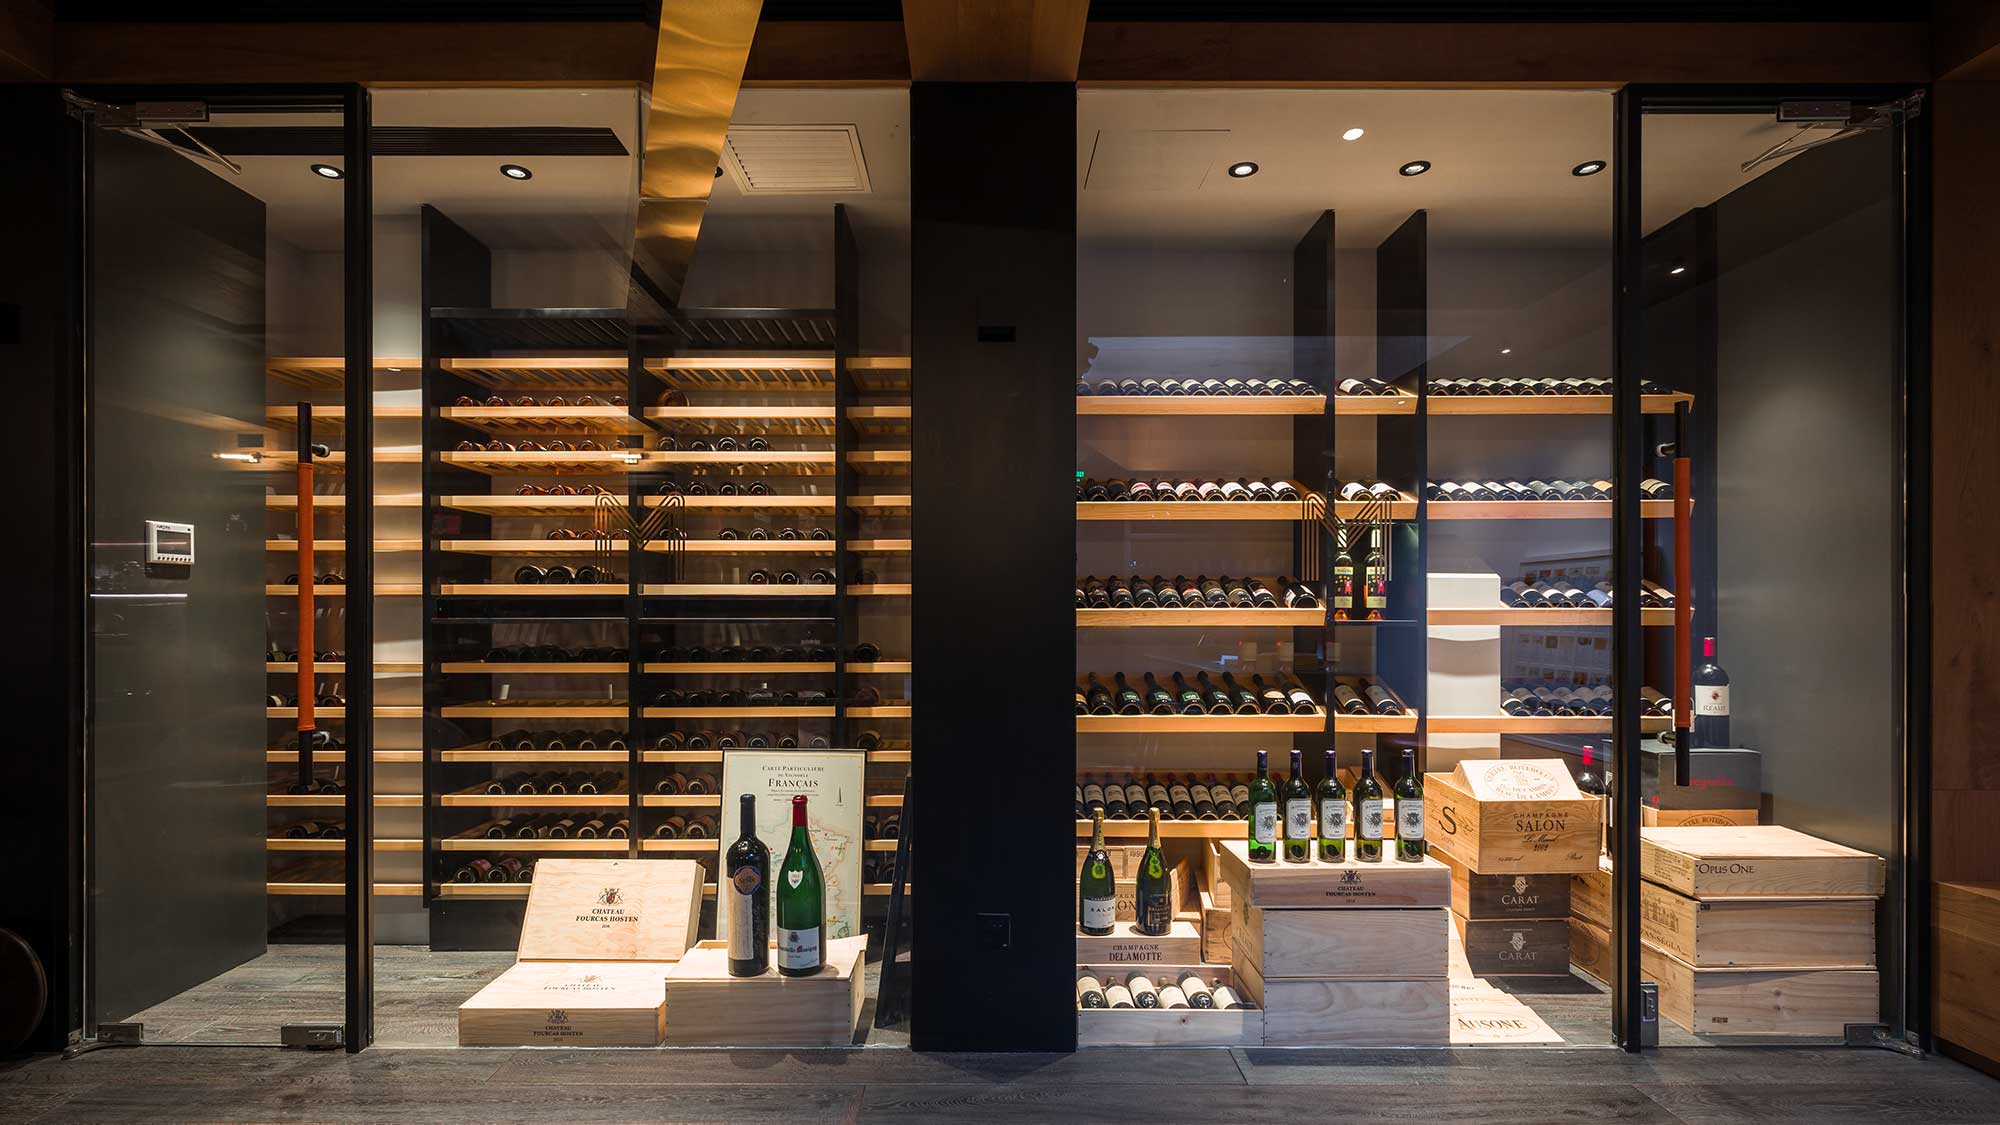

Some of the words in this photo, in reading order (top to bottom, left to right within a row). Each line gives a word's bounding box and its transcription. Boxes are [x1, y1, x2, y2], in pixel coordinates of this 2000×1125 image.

[768, 779, 819, 788] FRANÇAIS
[1516, 819, 1566, 832] SALON
[1109, 953, 1162, 961] DELAMOTTE
[1457, 1018, 1527, 1030] AUSONE
